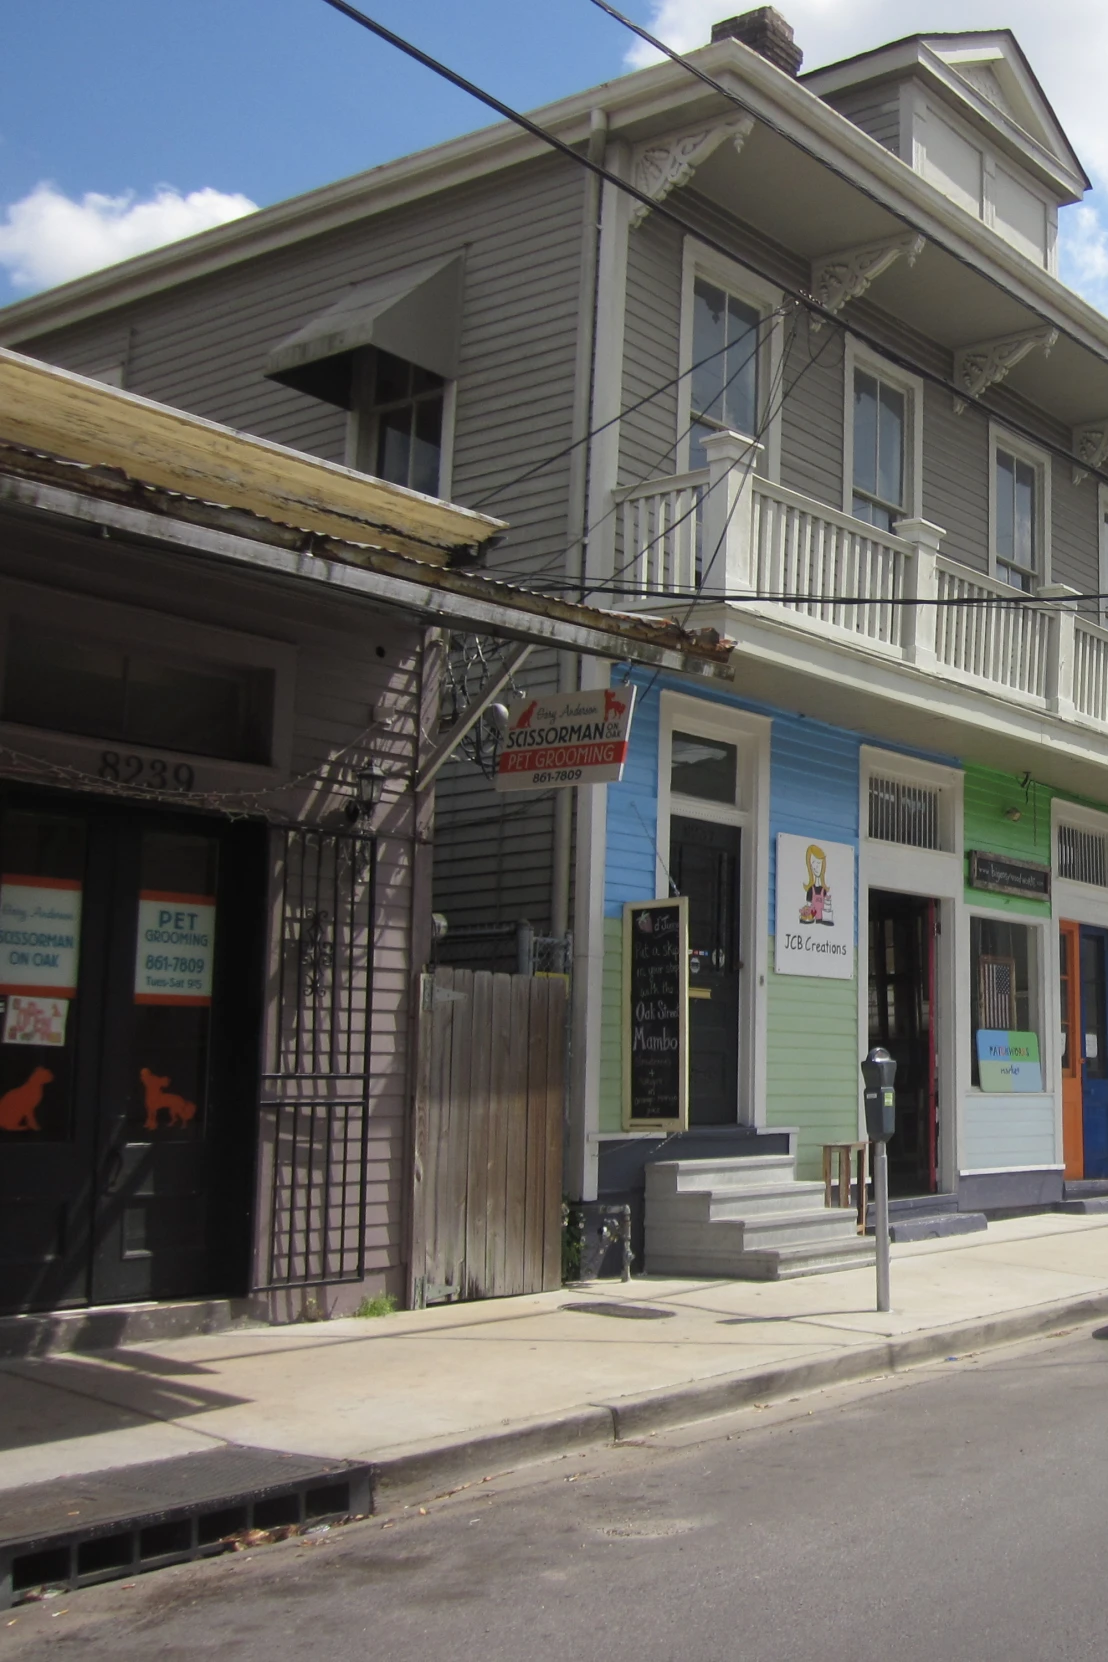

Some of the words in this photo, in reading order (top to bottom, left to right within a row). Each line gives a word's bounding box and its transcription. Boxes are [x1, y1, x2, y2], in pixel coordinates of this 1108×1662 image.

[560, 702, 598, 718] Anderson
[506, 722, 606, 749] SCISSORMAN
[605, 729, 622, 739] OAK
[606, 722, 620, 731] ON
[507, 751, 533, 770] PET
[535, 744, 616, 768] GROOMING
[98, 751, 195, 792] 8239
[532, 769, 582, 784] 861-7809
[159, 910, 199, 931] PET
[145, 930, 208, 947] GROOMING
[784, 933, 803, 950] JCB
[805, 936, 847, 956] Creations
[10, 951, 30, 965] ON
[32, 953, 60, 968] OAK
[146, 955, 205, 974] 861-7809
[636, 1001, 656, 1021] Oak
[657, 1000, 680, 1020] Street
[633, 1026, 679, 1051] Mambo
[989, 1045, 1030, 1057] PATCHWORKS
